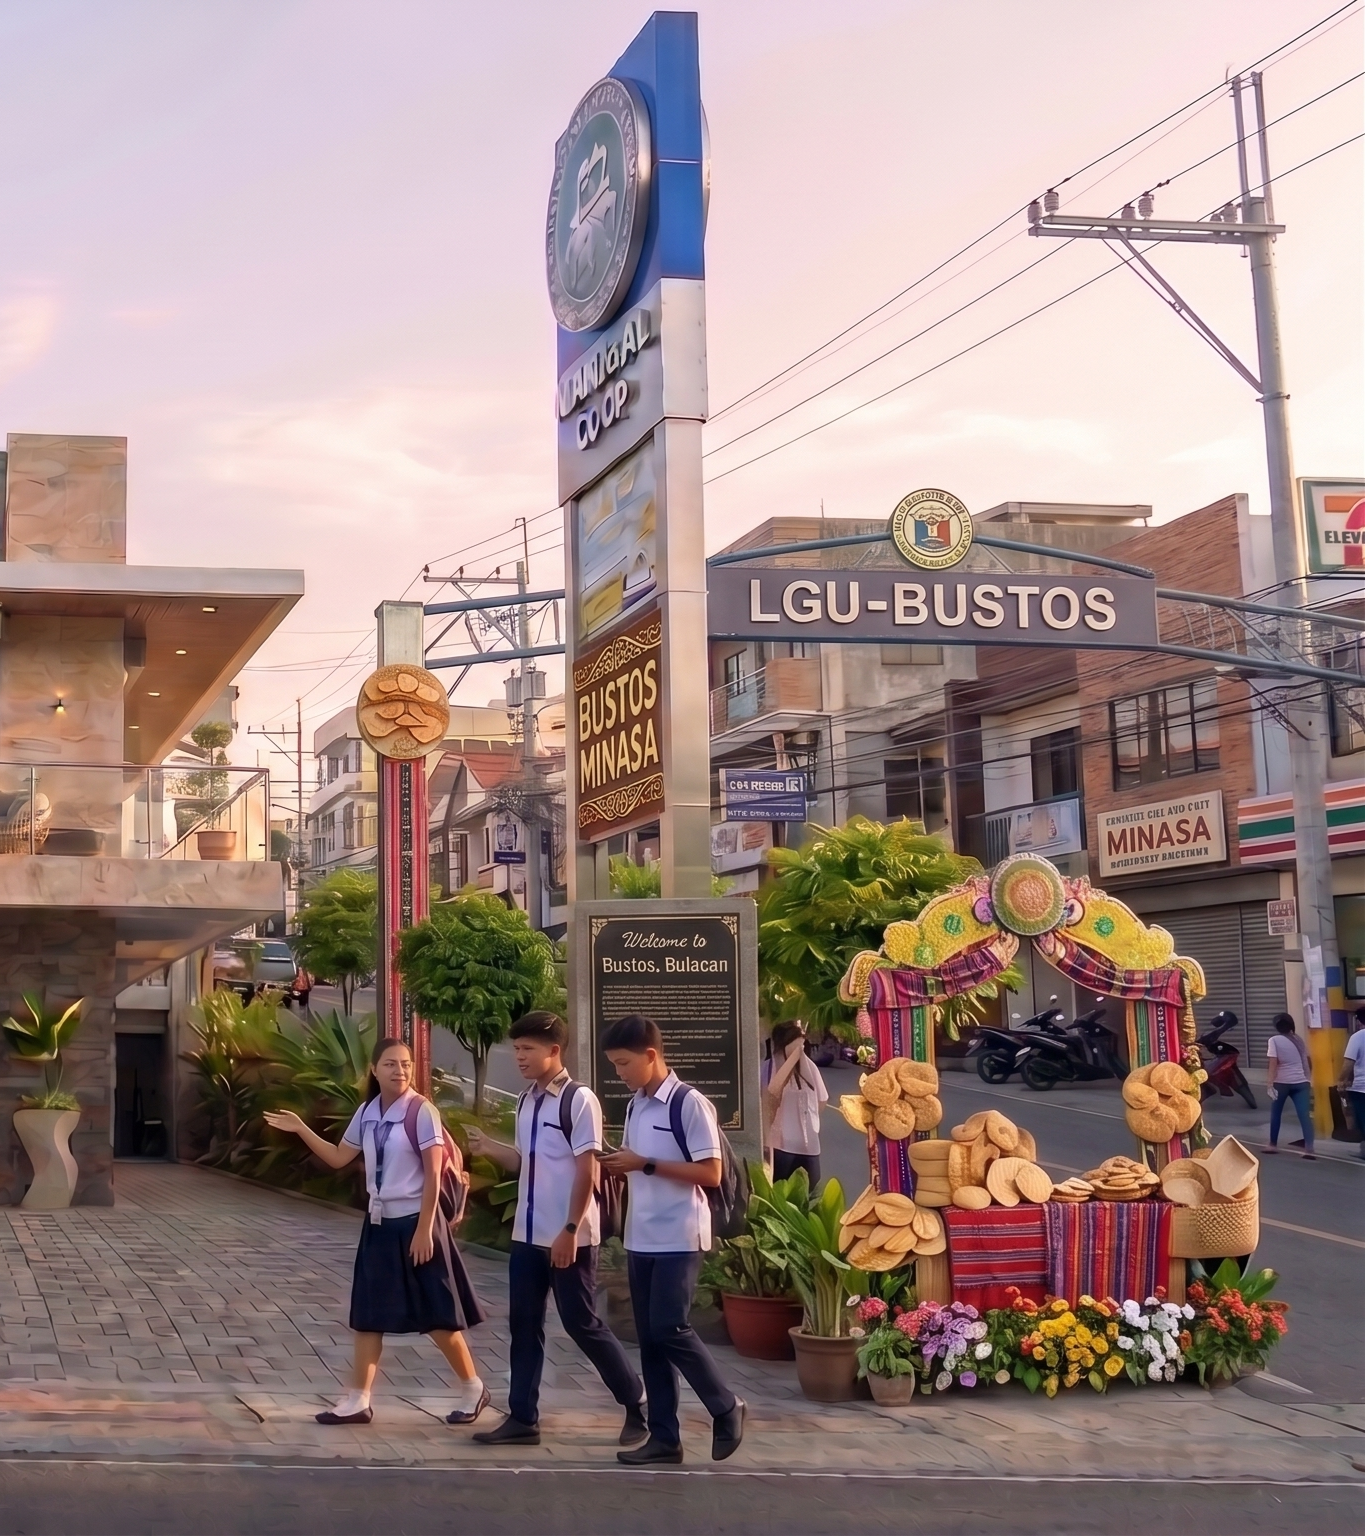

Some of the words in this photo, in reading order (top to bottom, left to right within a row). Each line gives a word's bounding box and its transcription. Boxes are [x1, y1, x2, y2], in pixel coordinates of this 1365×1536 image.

[1324, 530, 1365, 544] ELEV
[750, 579, 1117, 631] LGU-BUSTOS
[579, 659, 657, 742] BUSTOS
[580, 718, 659, 793] MINASA
[1107, 815, 1212, 857] MINASA
[622, 931, 688, 948] Welcome
[692, 933, 707, 948] to
[665, 956, 728, 973] Bulacan
